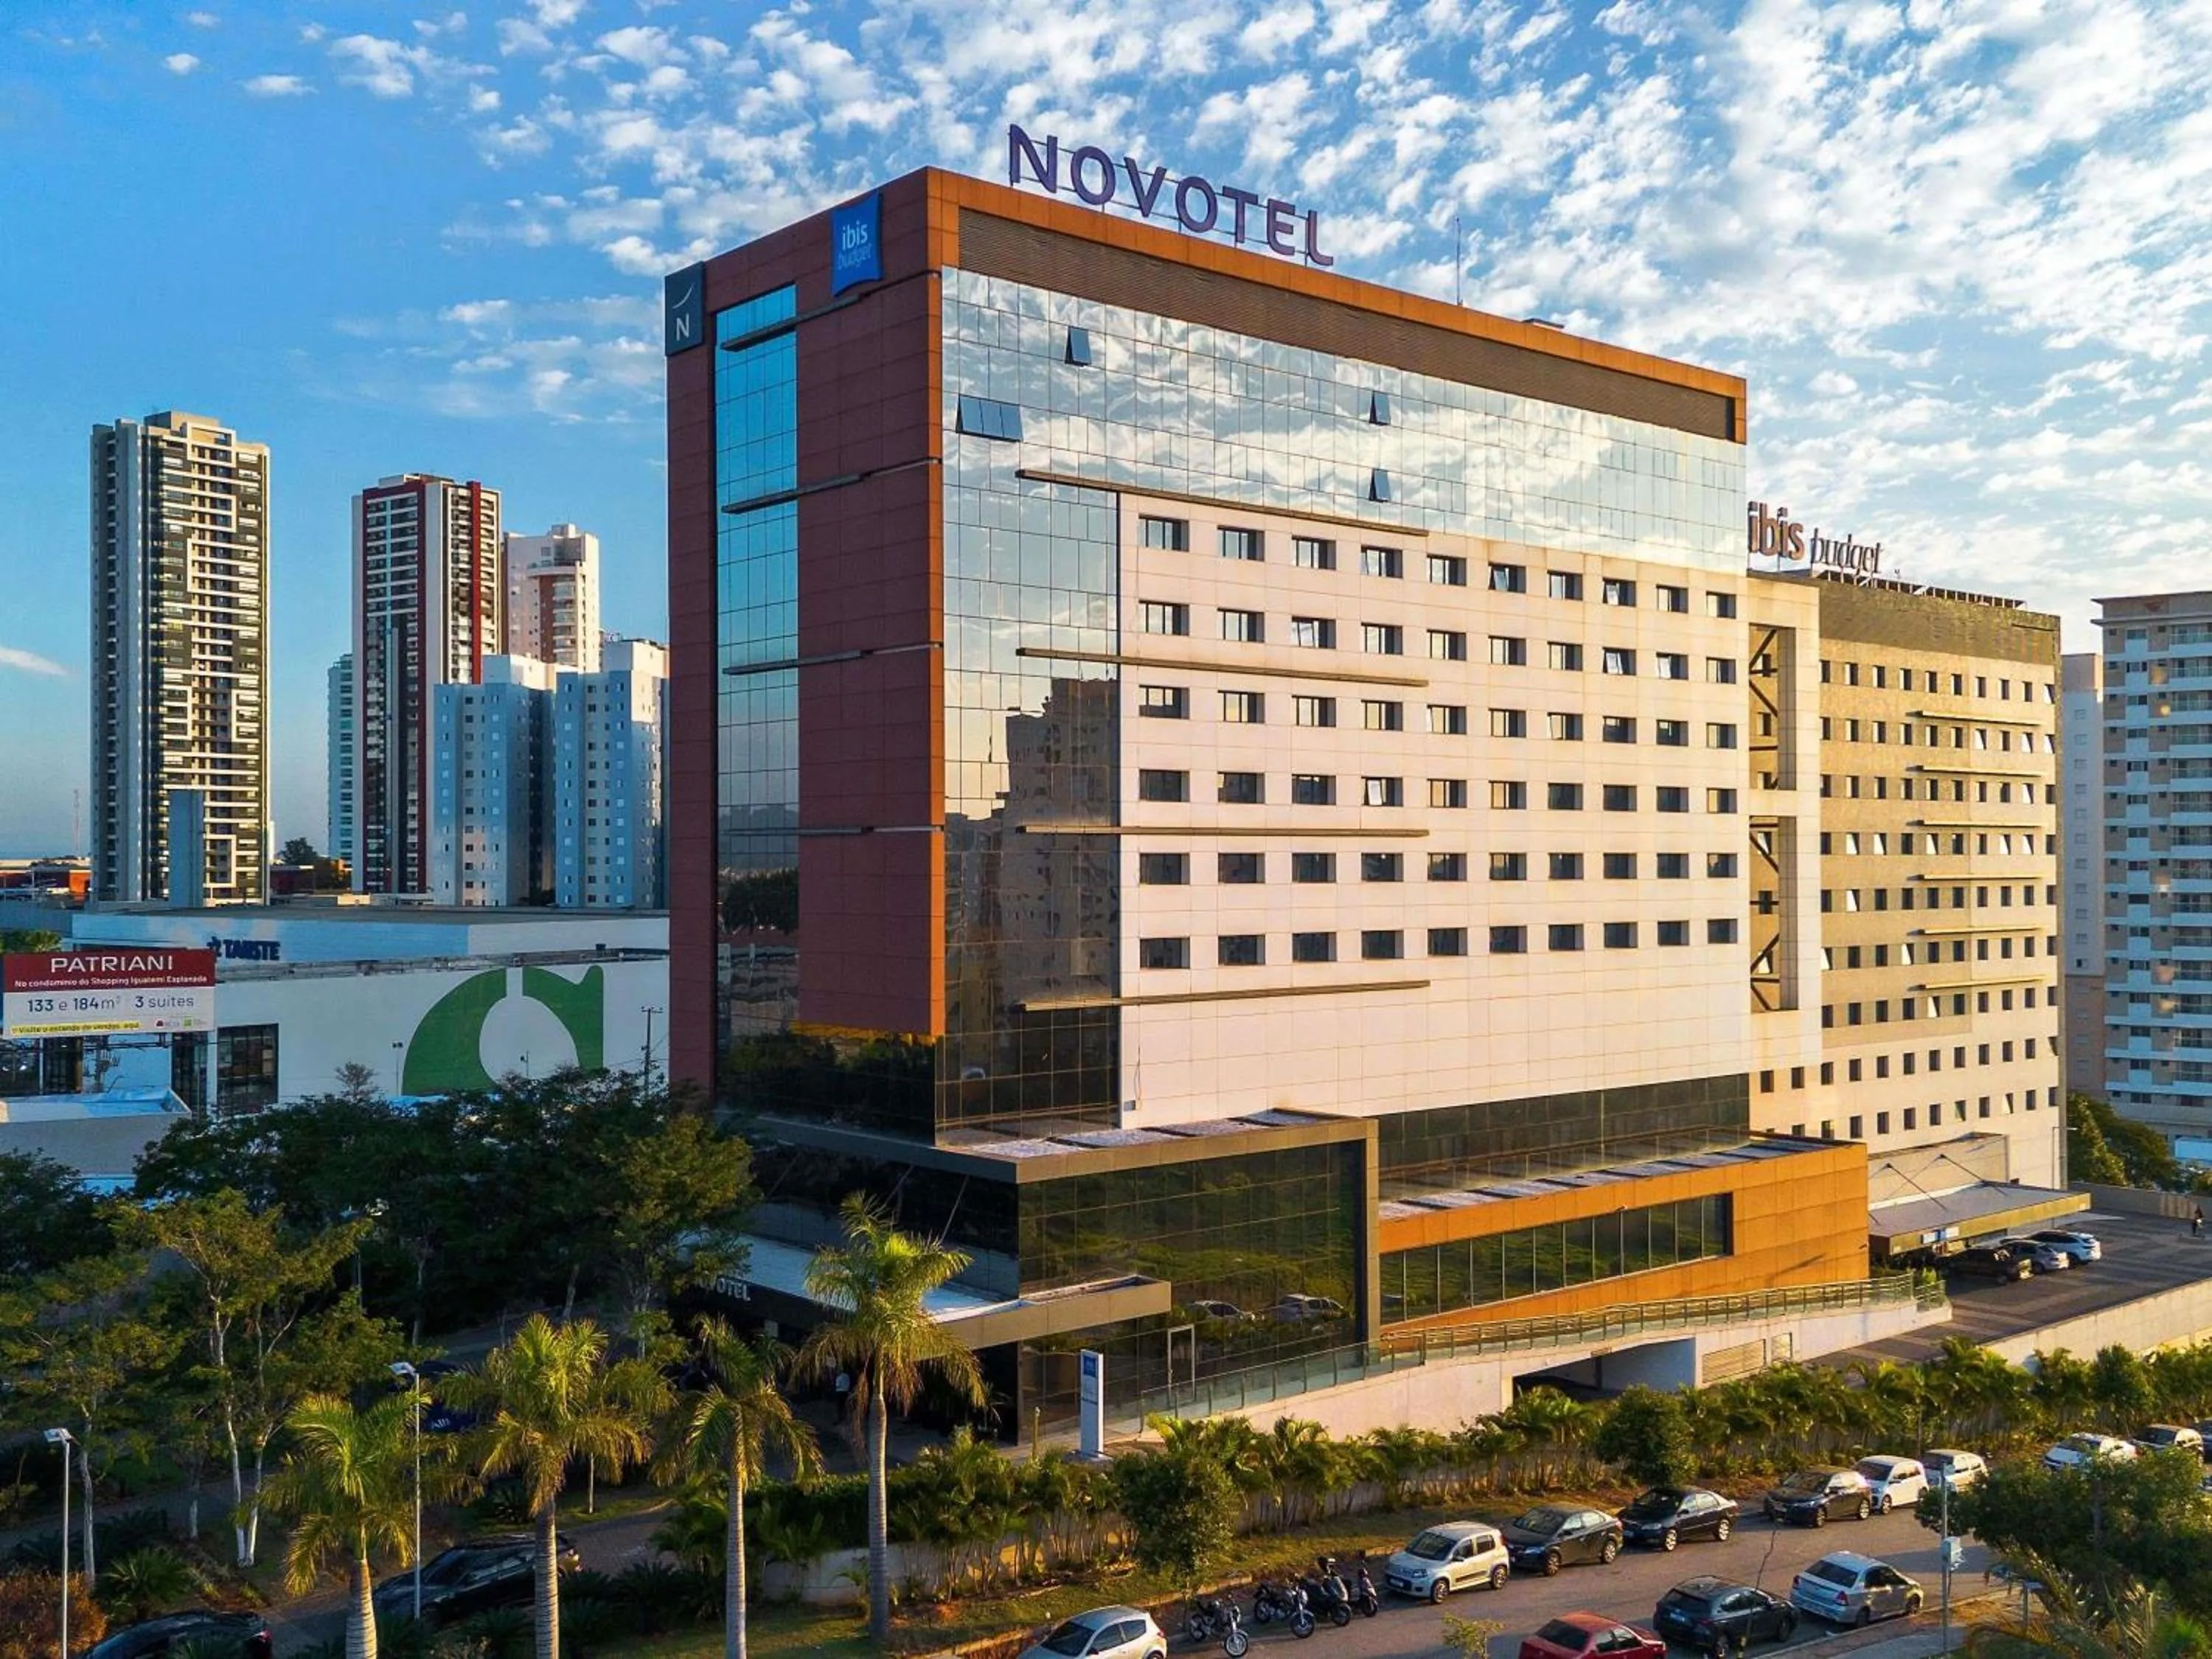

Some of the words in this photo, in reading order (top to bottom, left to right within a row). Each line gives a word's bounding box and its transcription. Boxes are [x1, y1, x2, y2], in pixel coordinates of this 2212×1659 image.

[1009, 123, 1334, 266] NOVOTEL
[842, 220, 869, 251] ibis
[838, 243, 873, 270] budget
[676, 313, 689, 341] N
[1747, 501, 1806, 560] ibis
[1809, 527, 1884, 577] budget
[51, 956, 173, 973] PATRIANI
[91, 977, 129, 986] Shopping
[131, 976, 163, 984] Iguatemi
[167, 975, 207, 983] Esplanada
[28, 998, 54, 1012] 133
[58, 1001, 68, 1011] e
[135, 995, 145, 1008] 3
[148, 995, 195, 1008] suites
